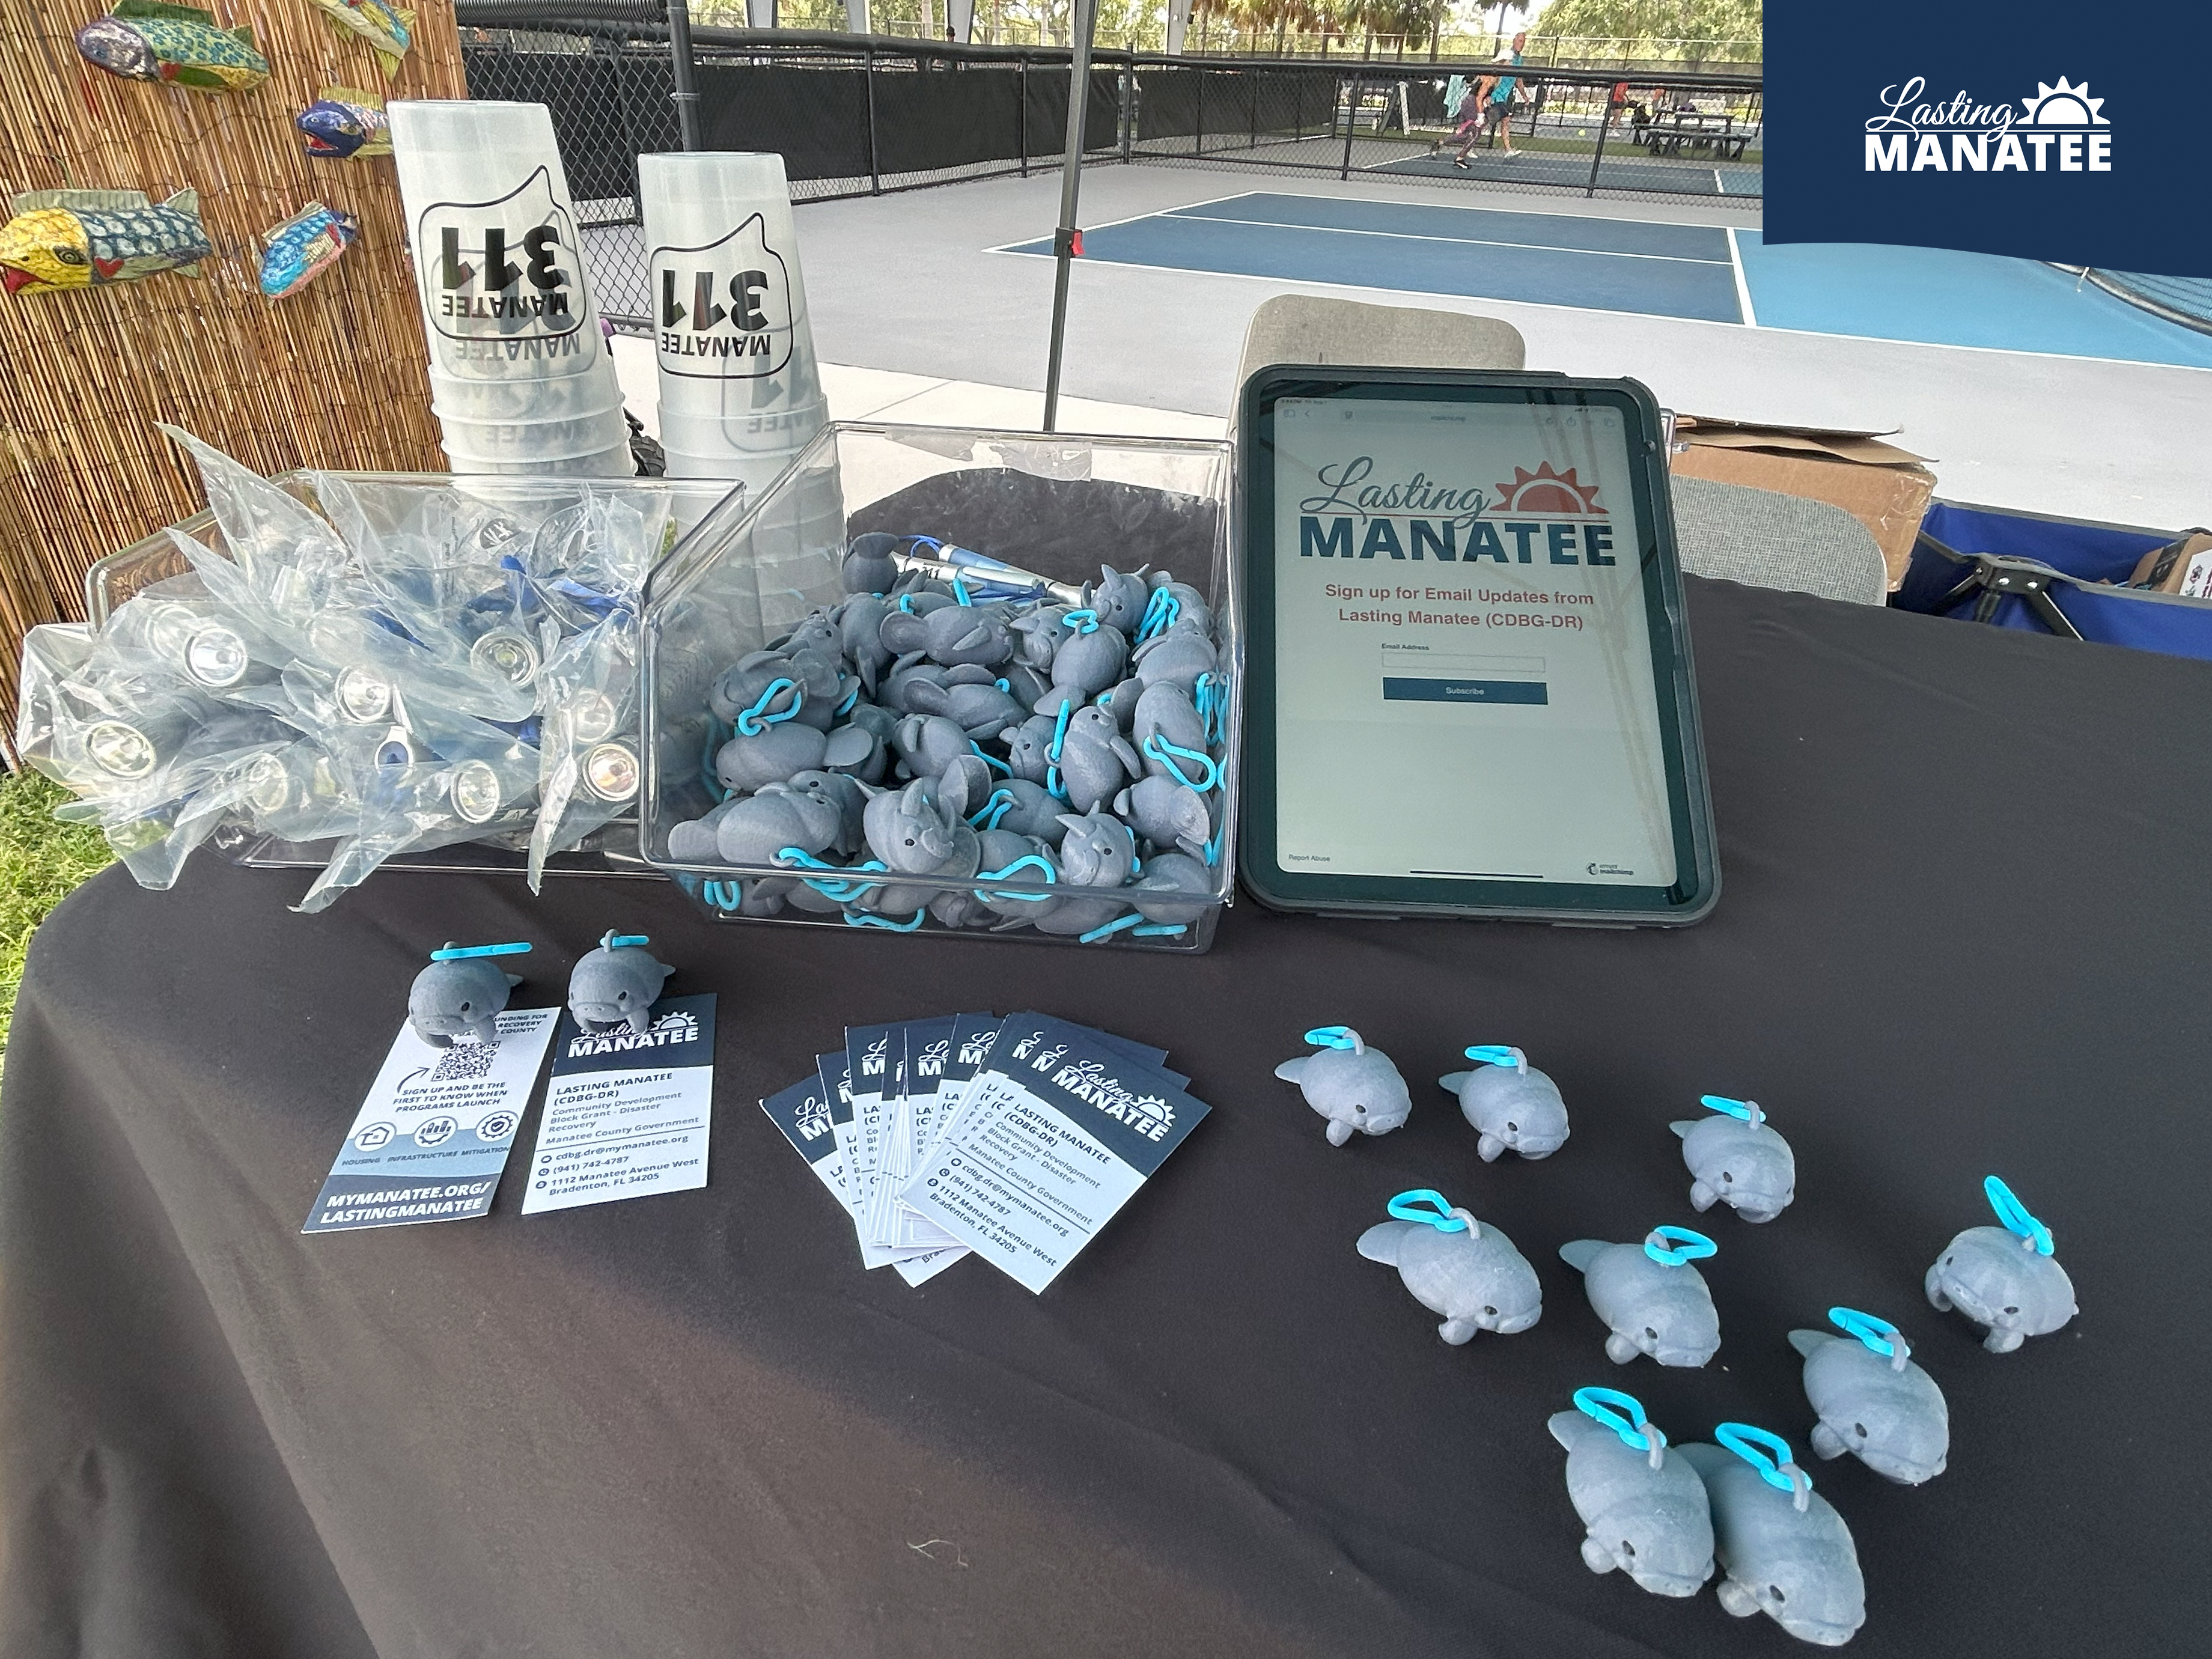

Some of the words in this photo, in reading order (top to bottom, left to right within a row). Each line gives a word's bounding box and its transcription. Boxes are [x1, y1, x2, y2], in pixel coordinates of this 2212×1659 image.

[442, 225, 564, 291] 311
[442, 293, 568, 318] MANATEE
[662, 269, 769, 332] 311
[662, 332, 771, 356] MANATEE
[1299, 455, 1491, 529] Lasting
[1300, 516, 1616, 567] MANATEE
[1325, 583, 1363, 600] Sign
[1369, 588, 1391, 602] up
[1395, 586, 1420, 600] for
[1425, 587, 1472, 601] Email
[1478, 589, 1549, 605] Updates
[1554, 591, 1594, 605] from
[1339, 608, 1402, 626] Lasting
[1409, 610, 1480, 626] Manatee
[1485, 612, 1583, 631] (CDBG-DR)
[1445, 686, 1485, 695] Subscribe
[1288, 854, 1310, 862] Report
[568, 1027, 698, 1058] MANATEE
[393, 1096, 421, 1104] FIRST
[439, 1092, 473, 1101] KNOW
[476, 1089, 508, 1098] WHEN
[556, 1082, 610, 1095] LASTING
[614, 1073, 672, 1088] MANATEE
[1064, 1060, 1134, 1106] Lasting
[395, 1102, 455, 1112] PROGRAMS
[457, 1098, 501, 1107] LAUNCH
[552, 1102, 612, 1116] Community
[614, 1092, 682, 1107] Development
[554, 1091, 619, 1106] (CDBG-DR)
[1051, 1068, 1169, 1142] MANATEE
[549, 1121, 597, 1133] Recovery
[550, 1114, 578, 1124] Block
[581, 1110, 611, 1120] Grant
[620, 1103, 661, 1115] Disaster
[546, 1133, 592, 1145] Manatee
[595, 1127, 632, 1138] County
[635, 1117, 699, 1132] Government
[1004, 1111, 1058, 1148] (CDBG-DR)
[1014, 1103, 1059, 1133] LASTING
[1059, 1130, 1111, 1165] MANATEE
[388, 1151, 458, 1163] INFRASTRUCTURE
[461, 1146, 510, 1156] MITIGATION
[555, 1135, 689, 1160] cdbg.dr@mymanatee.org
[979, 1134, 1018, 1161] Recovery
[987, 1127, 1011, 1145] Block
[1011, 1142, 1036, 1161] Grant
[1040, 1160, 1076, 1186] Disaster
[995, 1121, 1043, 1153] Community
[1043, 1150, 1101, 1189] Development
[342, 1157, 380, 1166] HOUSING
[552, 1177, 576, 1187] 1112
[579, 1169, 626, 1182] Manatee
[629, 1163, 670, 1175] Avenue
[672, 1158, 699, 1168] West
[553, 1164, 580, 1175] (941)
[582, 1156, 630, 1169] 742-4787
[326, 1181, 492, 1208] MYMANATEE.ORG/
[549, 1181, 610, 1196] Bradenton,
[628, 1172, 659, 1184] 34205
[949, 1174, 973, 1193] (941)
[972, 1188, 1011, 1217] 742-4787
[968, 1143, 1005, 1170] Manatee
[1006, 1166, 1037, 1190] County
[1037, 1187, 1092, 1226] Government
[320, 1197, 484, 1224] LASTINGMANATEE
[961, 1164, 1069, 1238] cdbg.dr@mymanatee.org
[929, 1193, 976, 1229] Bradenton,
[978, 1225, 988, 1236] FL
[989, 1232, 1017, 1254] 34205
[939, 1185, 960, 1202] 1112
[958, 1199, 998, 1227] Manatee
[997, 1225, 1032, 1250] Avenue
[1033, 1246, 1057, 1267] West
